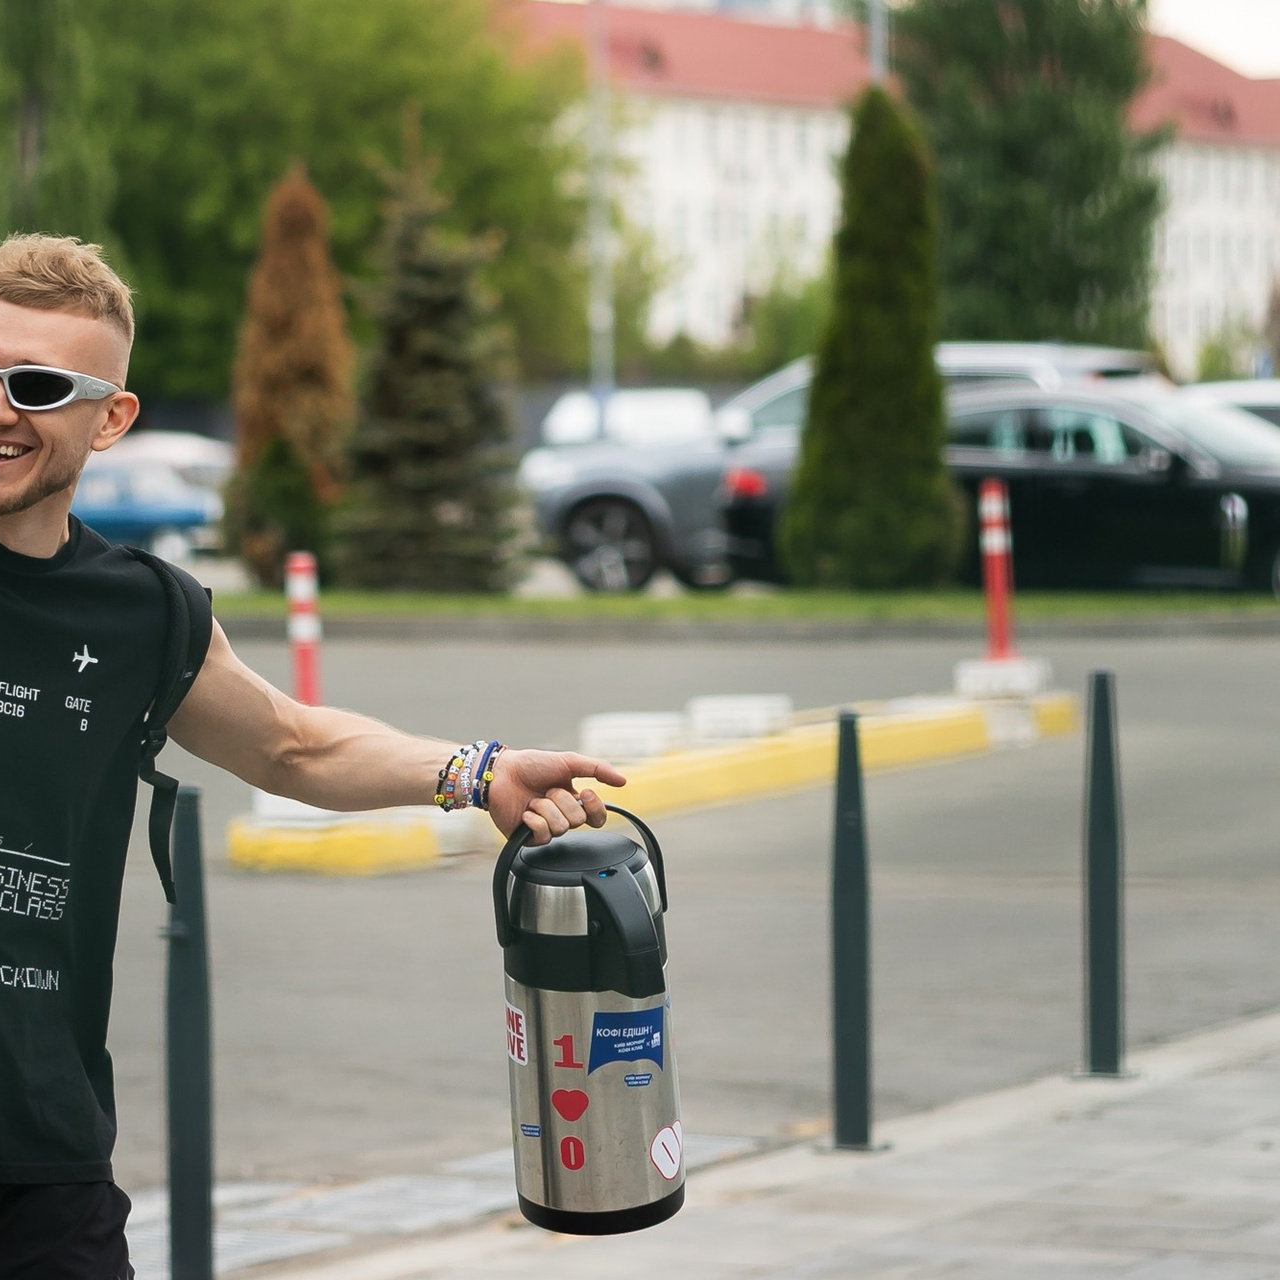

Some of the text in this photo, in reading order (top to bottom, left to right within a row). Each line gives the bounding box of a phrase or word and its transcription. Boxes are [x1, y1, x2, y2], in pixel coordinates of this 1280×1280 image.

[65, 695, 92, 713] GATE
[80, 718, 88, 731] B
[596, 1028, 621, 1037] КОФІ
[622, 1026, 649, 1038] ЕДІШН
